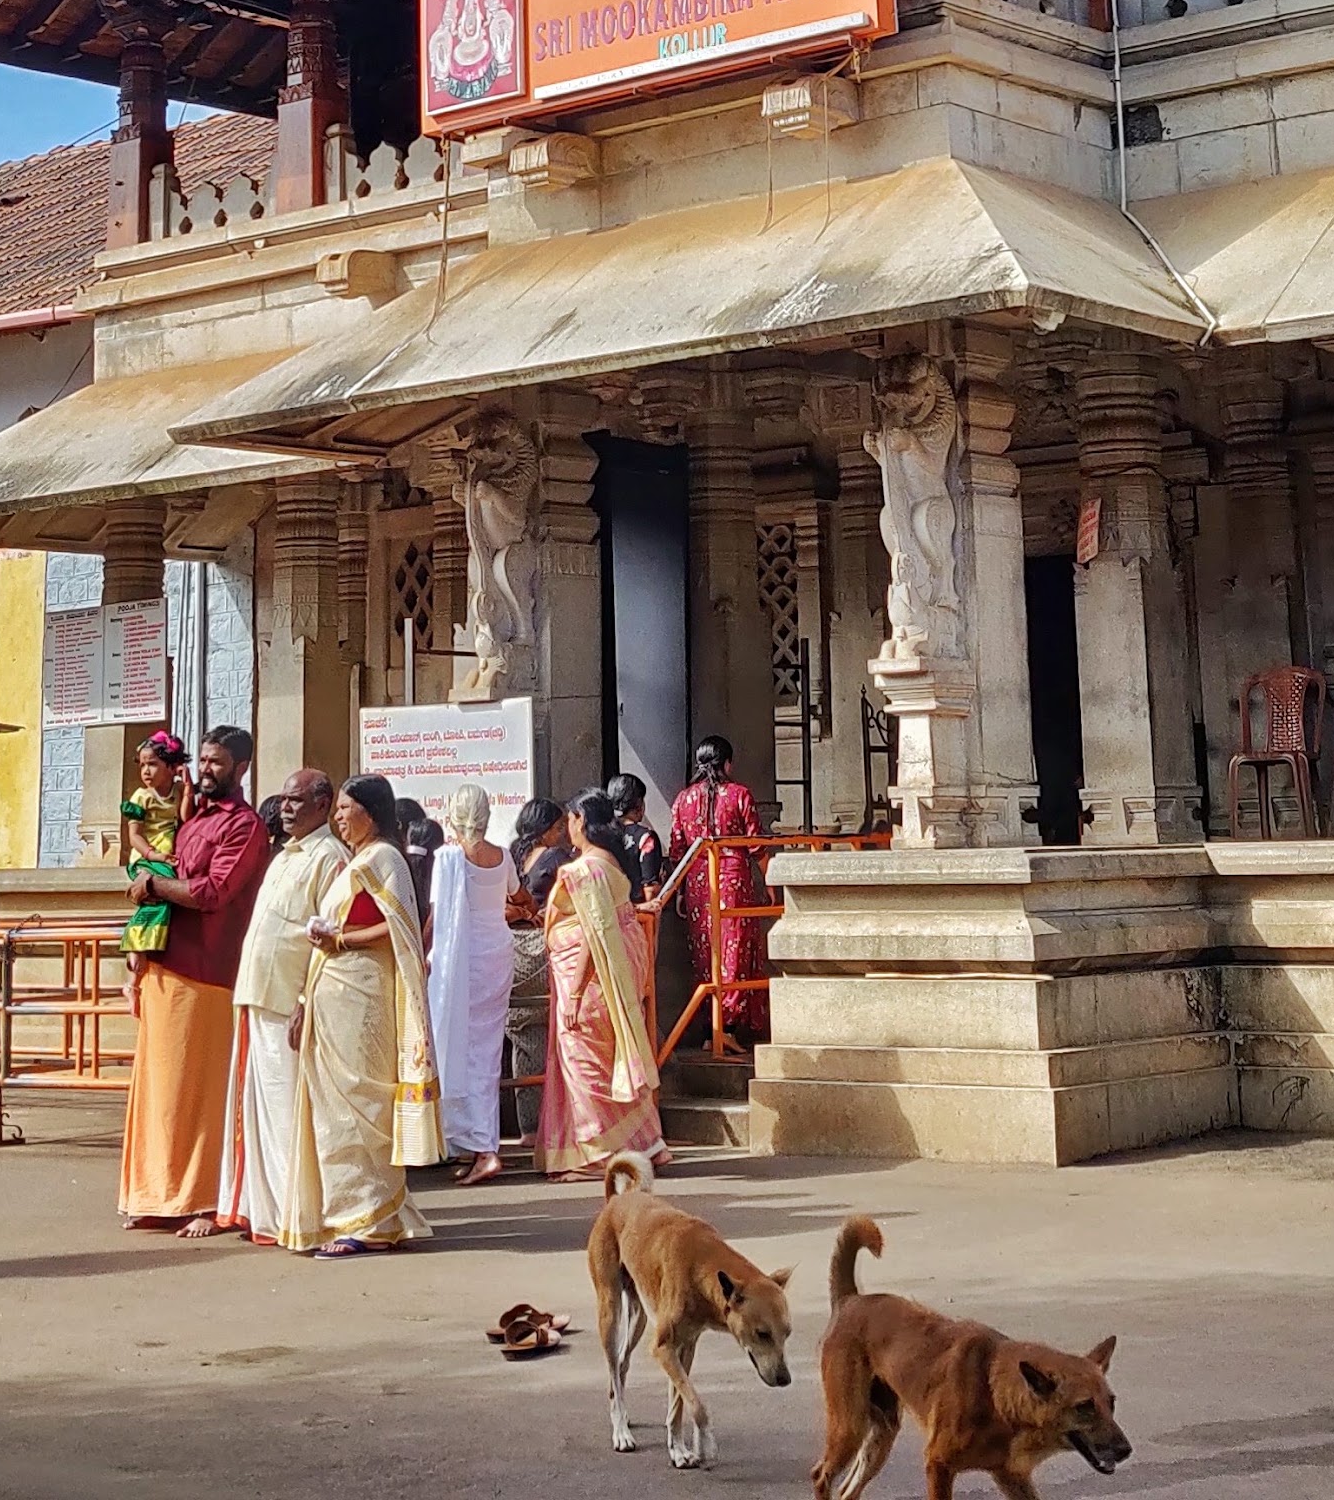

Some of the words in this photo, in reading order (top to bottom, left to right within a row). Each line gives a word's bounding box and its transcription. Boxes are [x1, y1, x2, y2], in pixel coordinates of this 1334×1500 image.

[534, 14, 572, 62] SRI
[658, 23, 727, 59] KOLLUR
[407, 764, 414, 775] &
